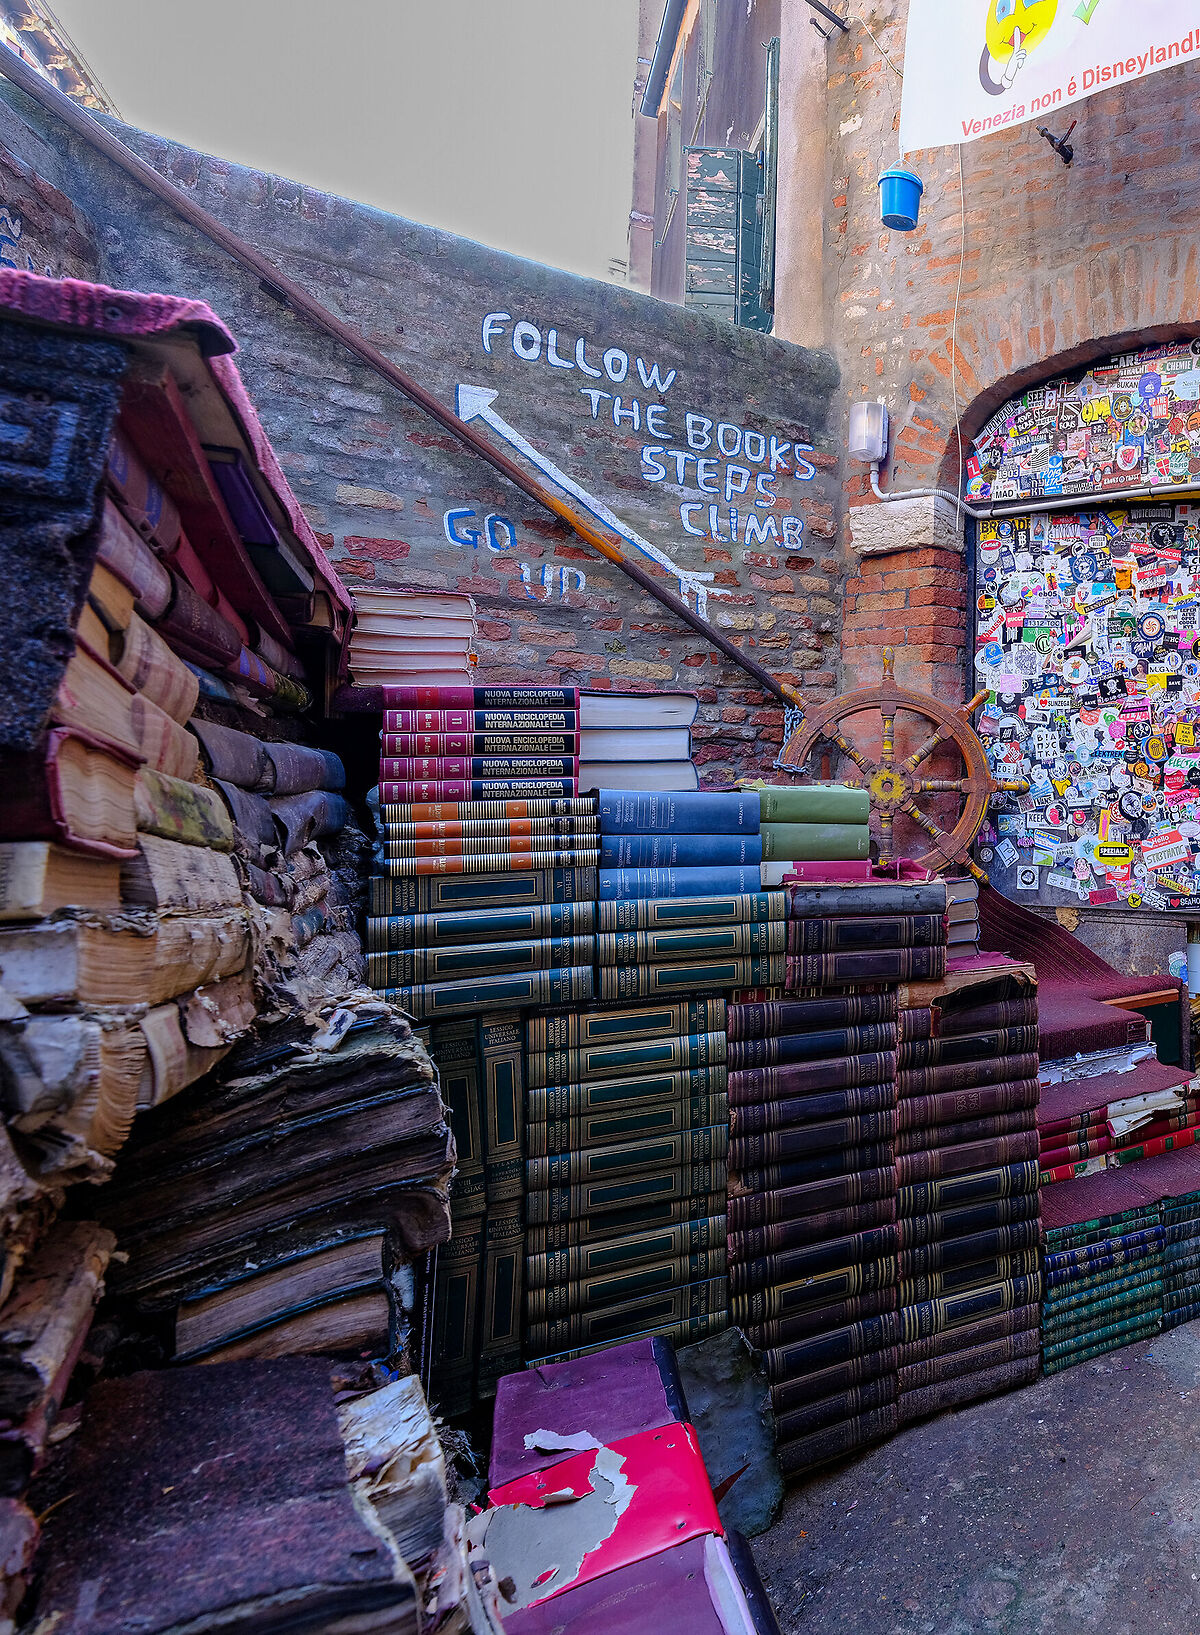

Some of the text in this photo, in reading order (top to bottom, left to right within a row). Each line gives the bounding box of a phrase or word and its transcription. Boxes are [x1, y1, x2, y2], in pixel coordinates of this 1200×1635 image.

[961, 29, 1200, 137] Venezia non é Disneyland!
[482, 312, 677, 393] FOLLOW
[1167, 360, 1191, 370] CHEMIE
[579, 388, 817, 480] THE BOOKS
[641, 446, 776, 508] STEPS
[999, 470, 1019, 479] 1903
[443, 507, 516, 552] GO
[520, 563, 586, 601] UP
[514, 690, 564, 698] ENCICLOPEDIA
[451, 717, 462, 725] 11
[485, 713, 565, 721] NUOVA ENCICLOPEDIA
[485, 721, 550, 729] INTERNAZIONALE
[485, 736, 564, 745] NUOVA ENCICLOPEDIA
[484, 744, 549, 752] INTERNAZIONALE
[482, 759, 563, 768] NUOVA ENCICLOPEDIA
[483, 767, 548, 775] INTERNAZIONALE
[482, 781, 563, 790] NUOVA ENCICLOPEDIA
[483, 789, 548, 797] INTERNAZIONALE
[1029, 813, 1044, 821] KEEP
[603, 879, 611, 888] 13
[554, 947, 561, 958] XX
[553, 981, 560, 989] XI
[489, 1024, 513, 1034] LESSICO
[485, 1029, 520, 1039] UNIVERSALE
[489, 1035, 516, 1045] ITALIANO
[956, 1095, 966, 1113] 1938
